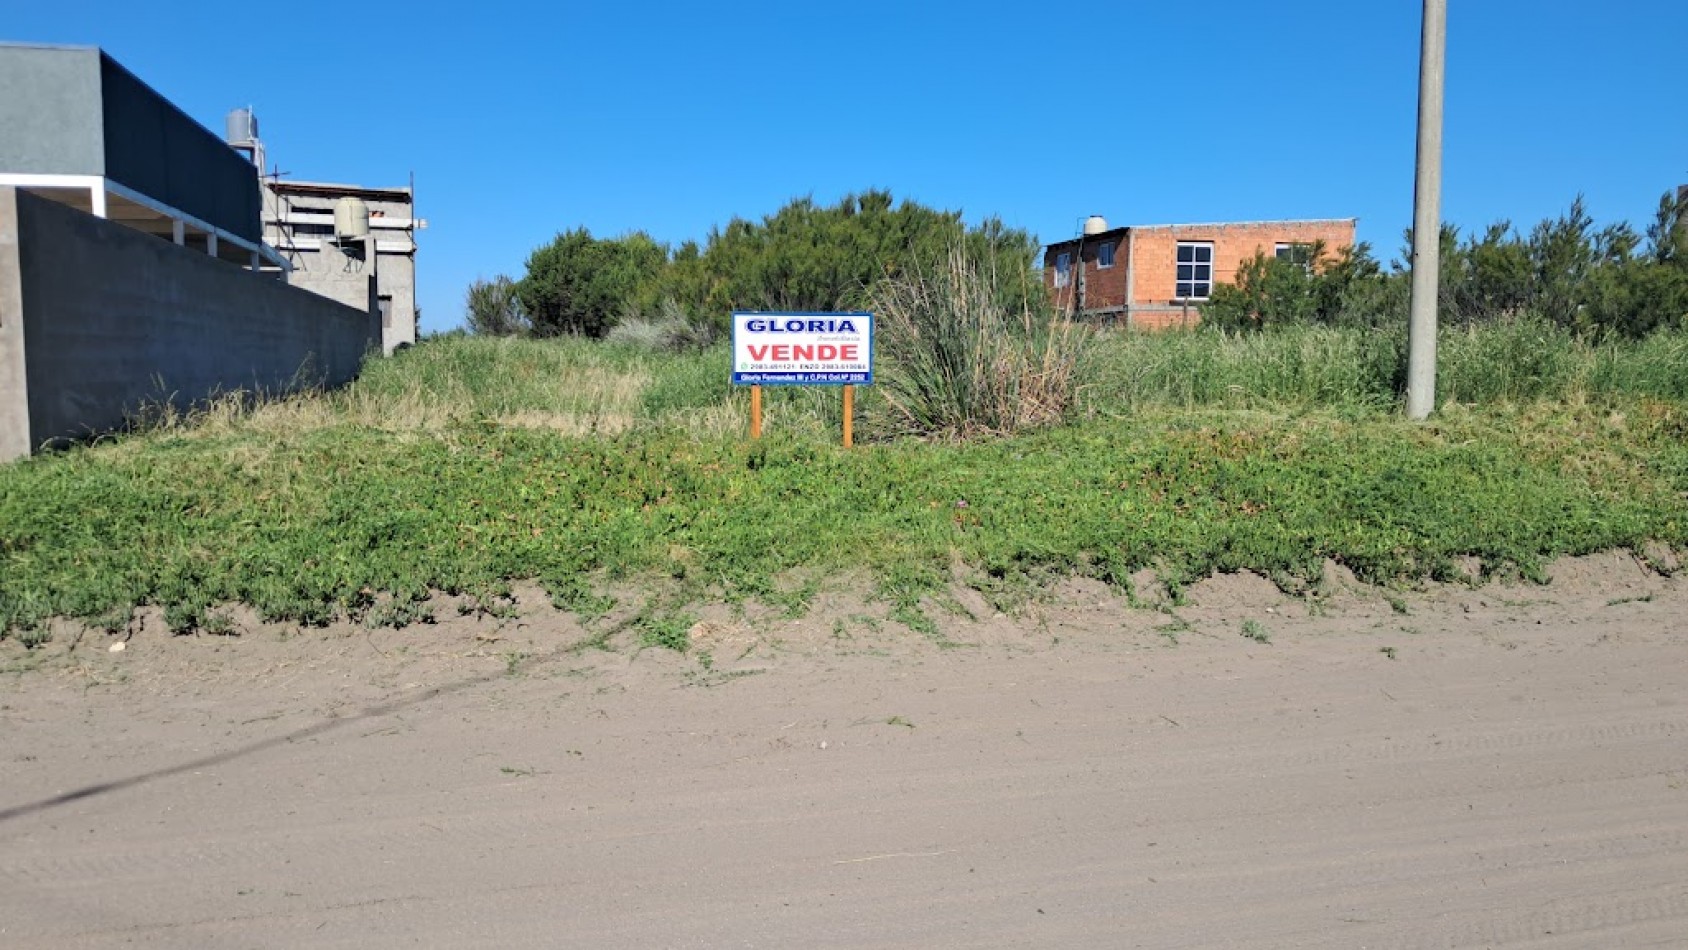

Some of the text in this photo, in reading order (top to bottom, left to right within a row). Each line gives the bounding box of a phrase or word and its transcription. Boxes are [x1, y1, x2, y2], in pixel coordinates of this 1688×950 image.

[746, 319, 857, 332] GLORIA
[747, 344, 858, 361] VENDE
[741, 373, 761, 381] Gloria
